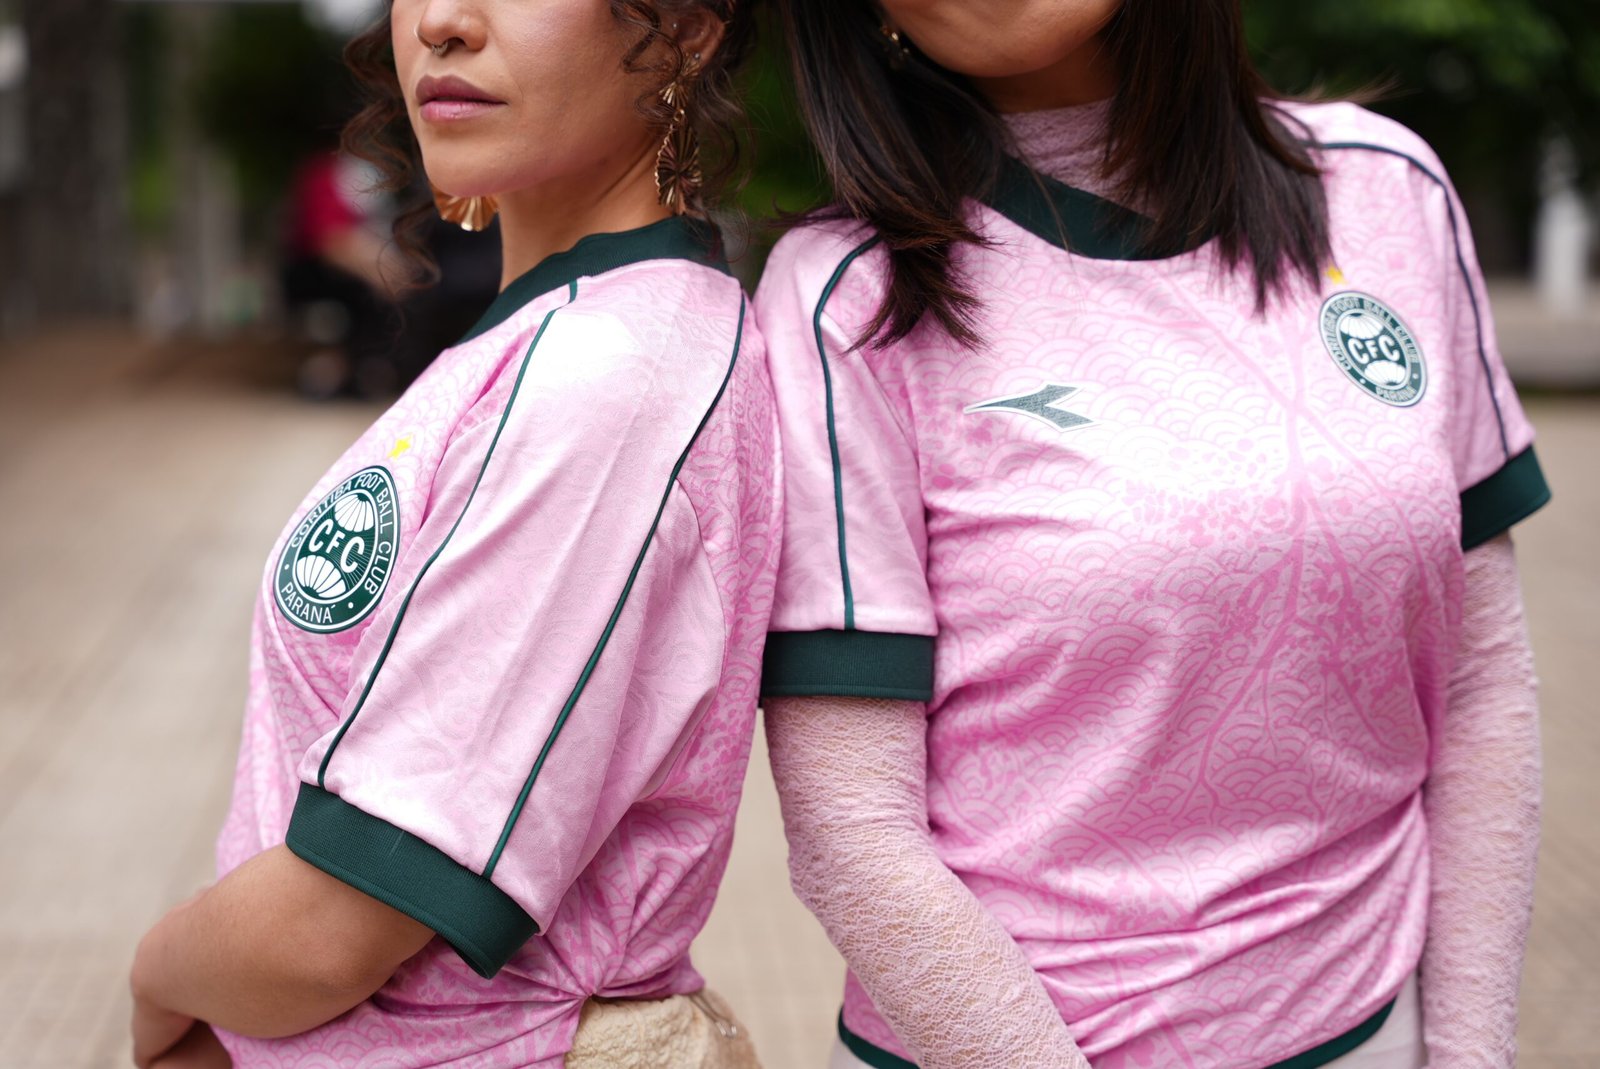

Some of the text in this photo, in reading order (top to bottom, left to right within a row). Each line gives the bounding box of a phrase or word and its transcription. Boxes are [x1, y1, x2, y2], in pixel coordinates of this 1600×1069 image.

[1347, 335, 1400, 364] CFC
[291, 473, 393, 594] CORITIBA FOOT BALL CLUB
[308, 518, 365, 573] CFC
